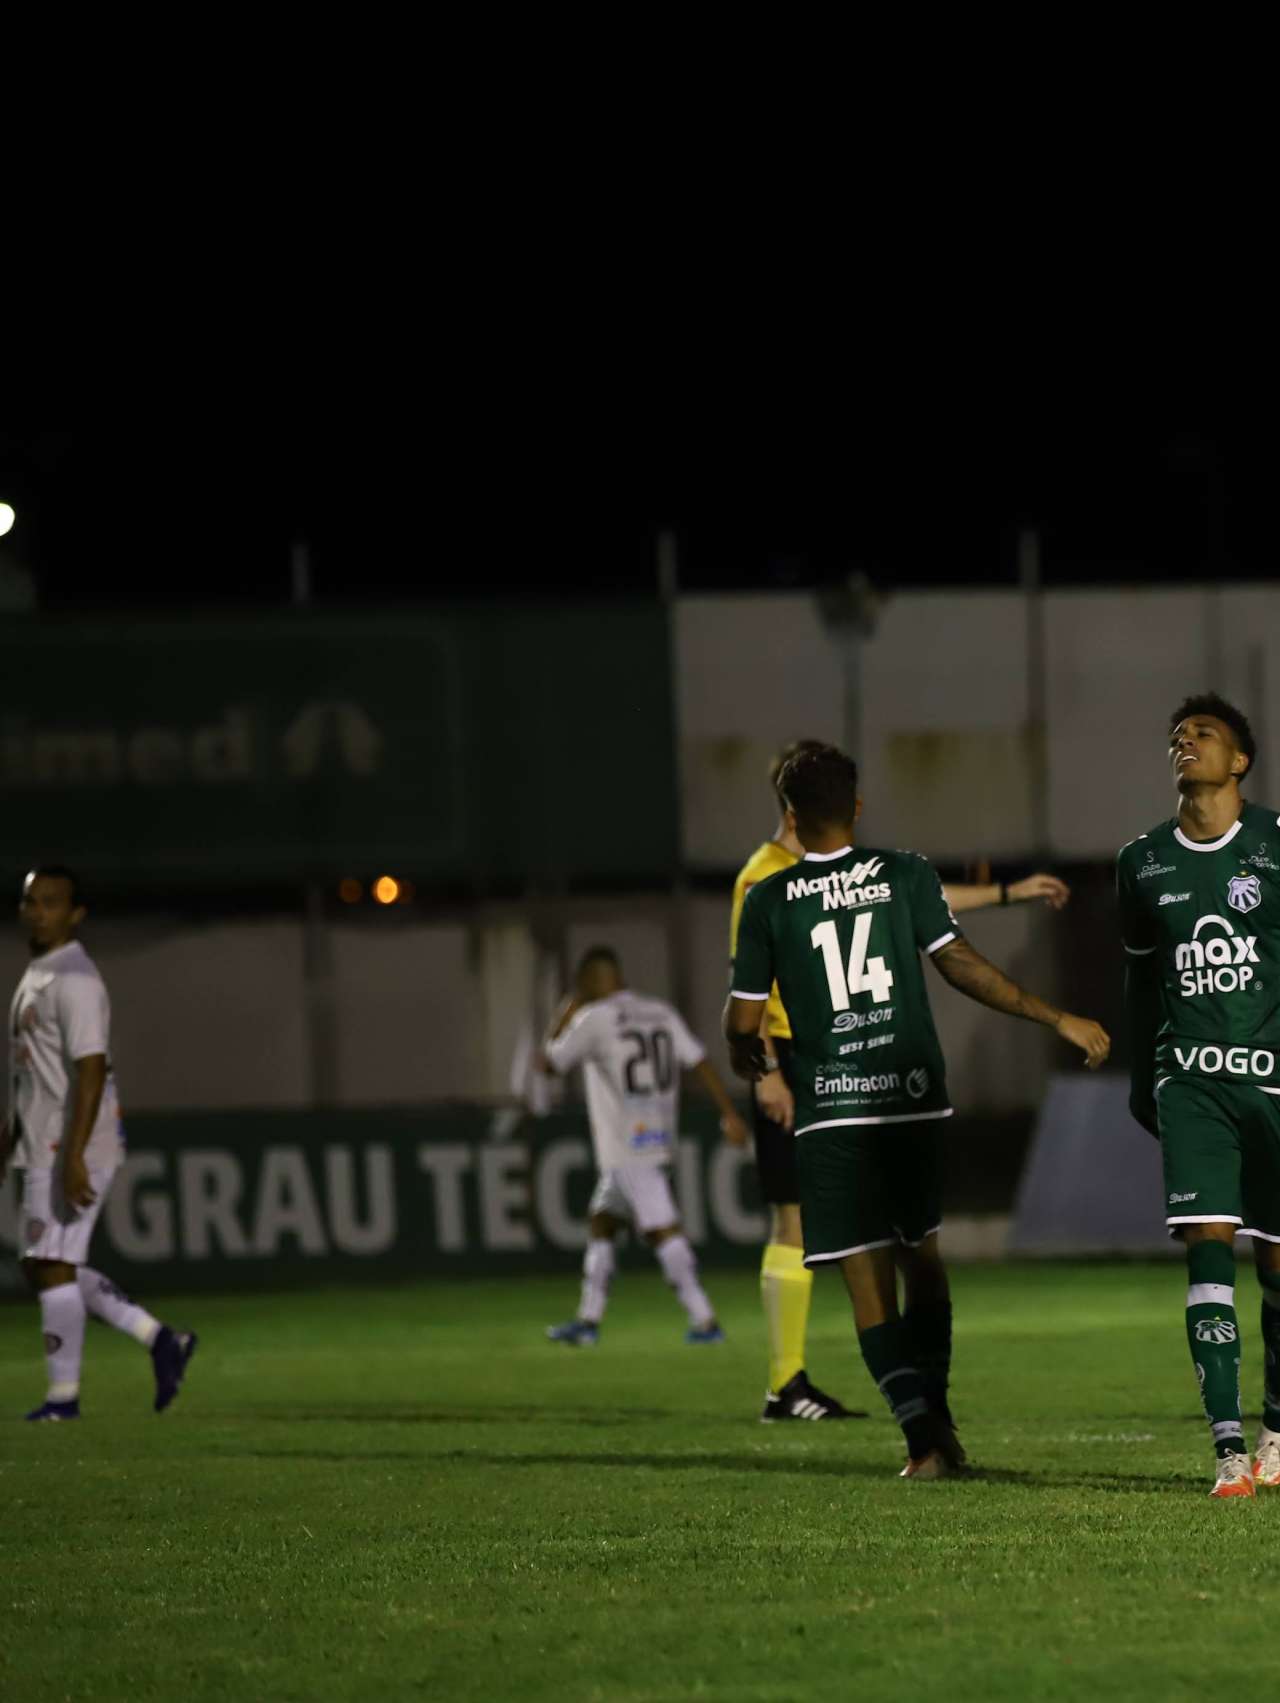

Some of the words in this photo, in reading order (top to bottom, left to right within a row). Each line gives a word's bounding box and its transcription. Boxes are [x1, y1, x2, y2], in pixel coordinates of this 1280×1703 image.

[822, 881, 892, 911] Minas
[810, 911, 893, 1012] 14
[1175, 935, 1261, 972] max
[1180, 965, 1254, 997] SHOP
[616, 1029, 675, 1095] 20
[1173, 1046, 1275, 1077] VOGO
[814, 1073, 900, 1096] Embracon
[104, 1143, 399, 1262] GRAU
[417, 1108, 771, 1255] TÉCIC
